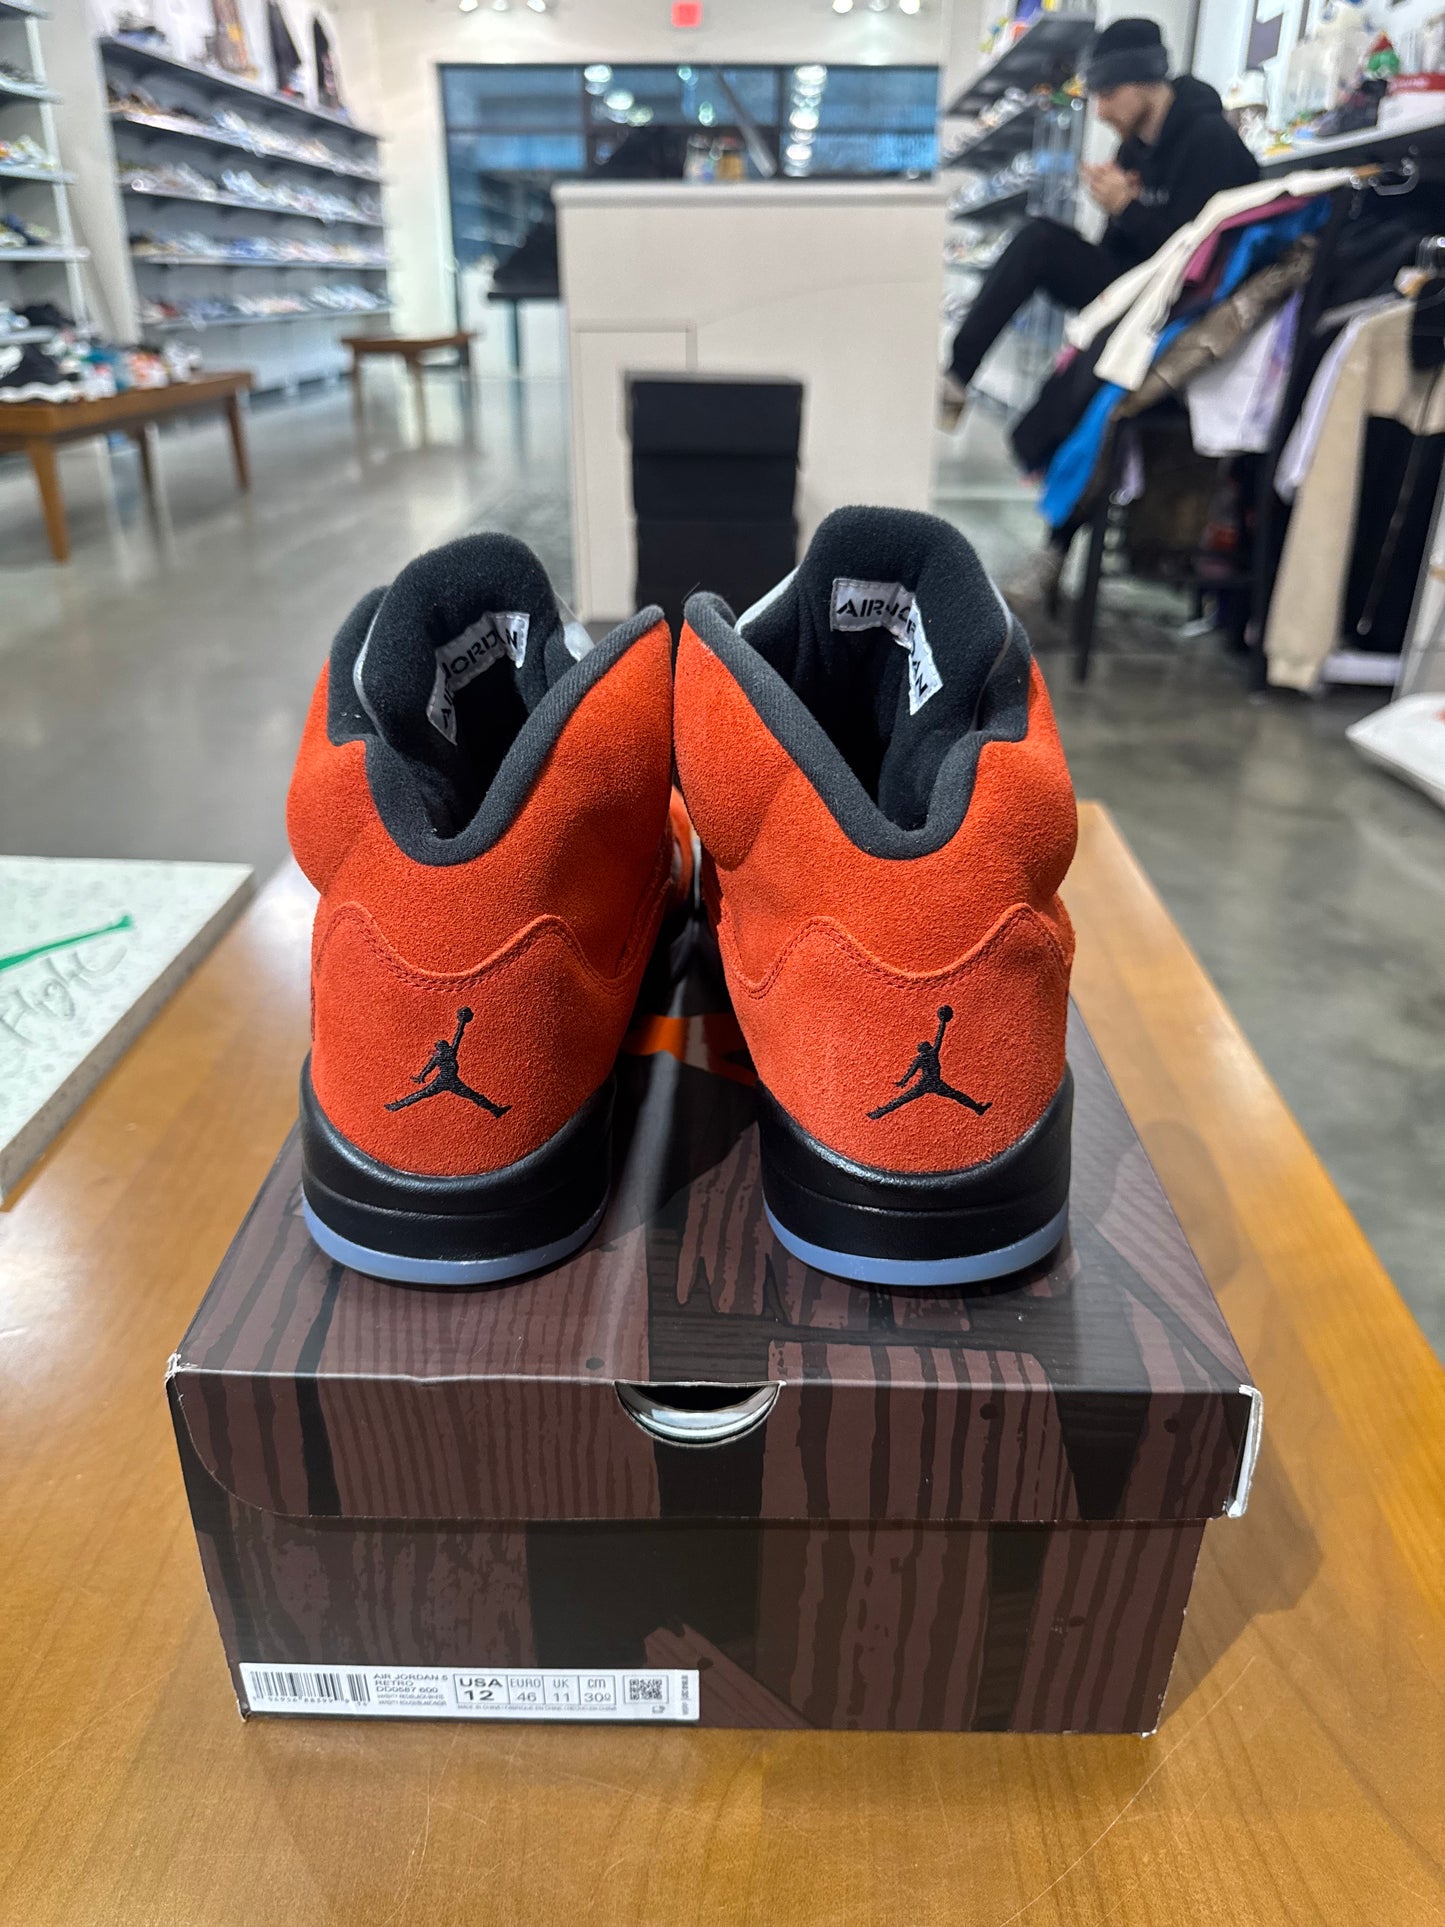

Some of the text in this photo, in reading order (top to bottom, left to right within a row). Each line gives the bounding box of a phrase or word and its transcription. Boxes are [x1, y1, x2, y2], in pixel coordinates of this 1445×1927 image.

[836, 598, 885, 618] AIR
[395, 1673, 439, 1681] JORDAN
[459, 1677, 503, 1688] USA
[510, 1678, 541, 1688] EURO
[553, 1678, 570, 1688] UK
[464, 1690, 495, 1701] 12
[517, 1691, 537, 1702] 46
[554, 1692, 571, 1702] 11
